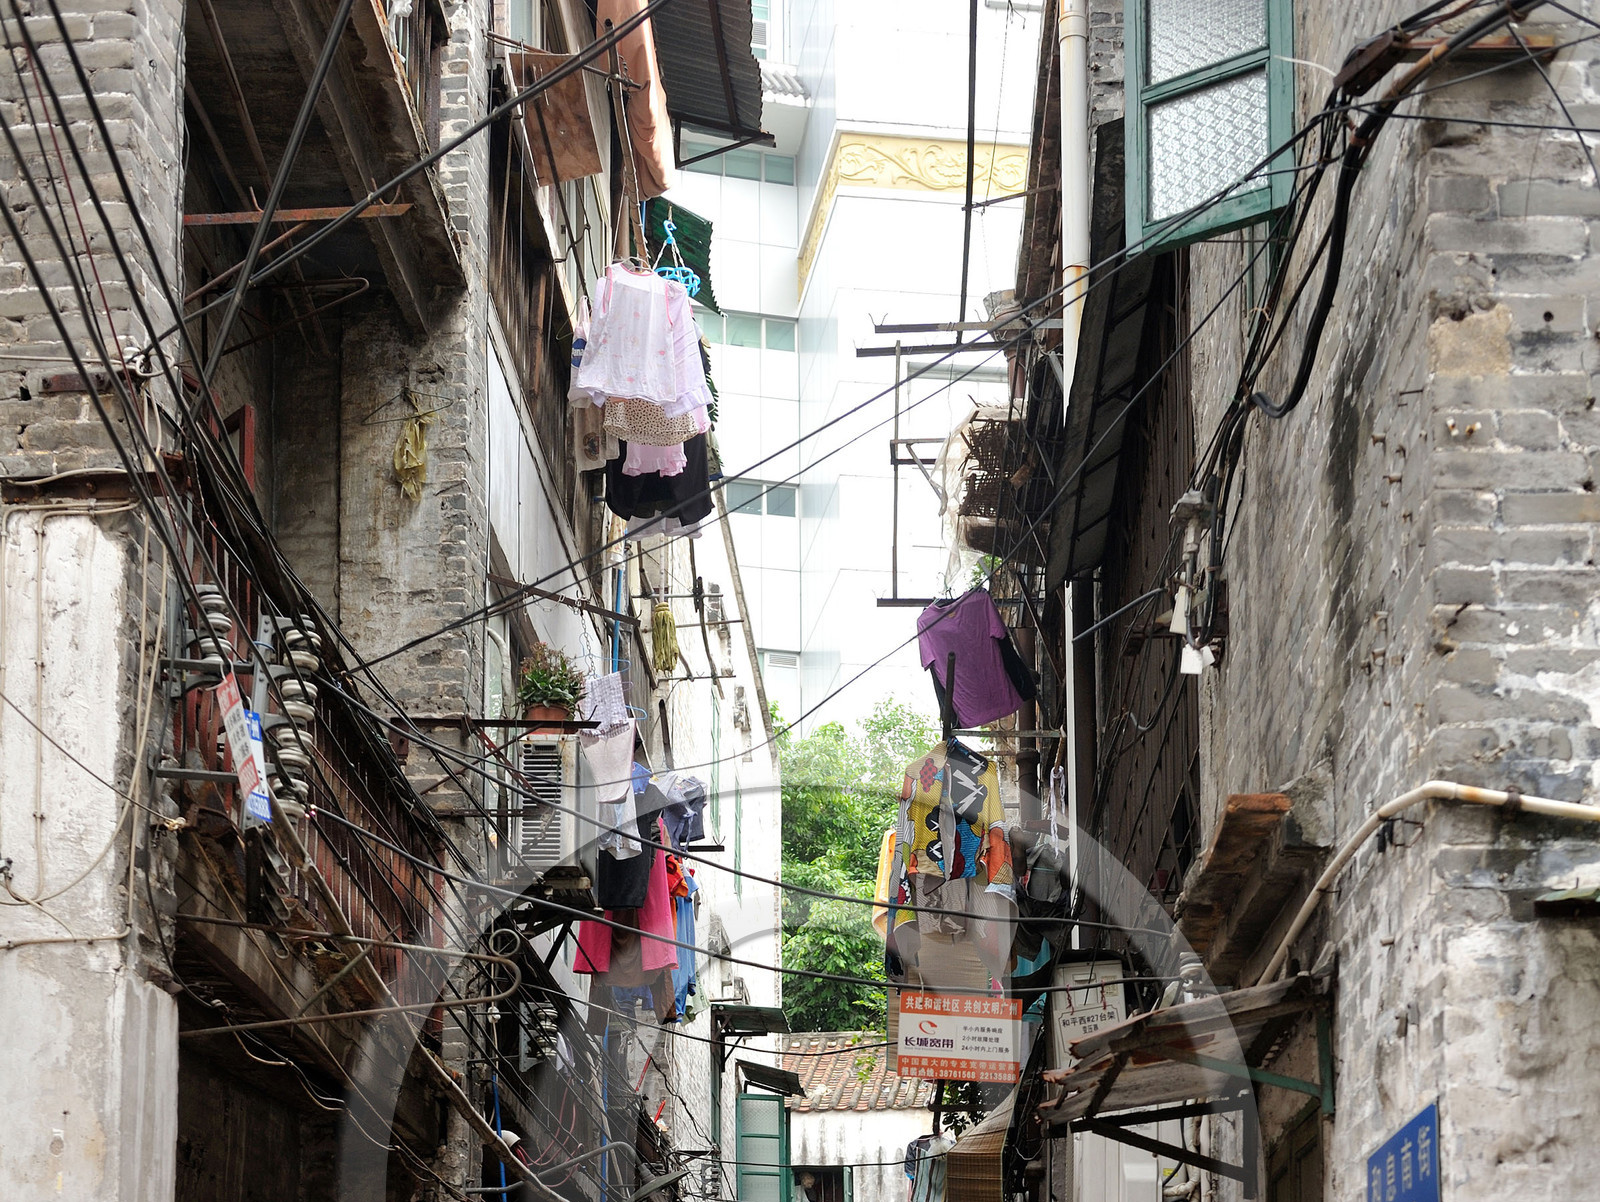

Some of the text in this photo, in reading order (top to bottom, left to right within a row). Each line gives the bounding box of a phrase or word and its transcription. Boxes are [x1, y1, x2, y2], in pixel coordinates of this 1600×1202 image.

[905, 996, 1017, 1015] 共建和谐社区 共创文明广州
[904, 1036, 954, 1048] 长城宽带
[961, 1045, 1010, 1053] 24小时内上门服务
[901, 1057, 1016, 1071] 中国最大的专业宽带运营商
